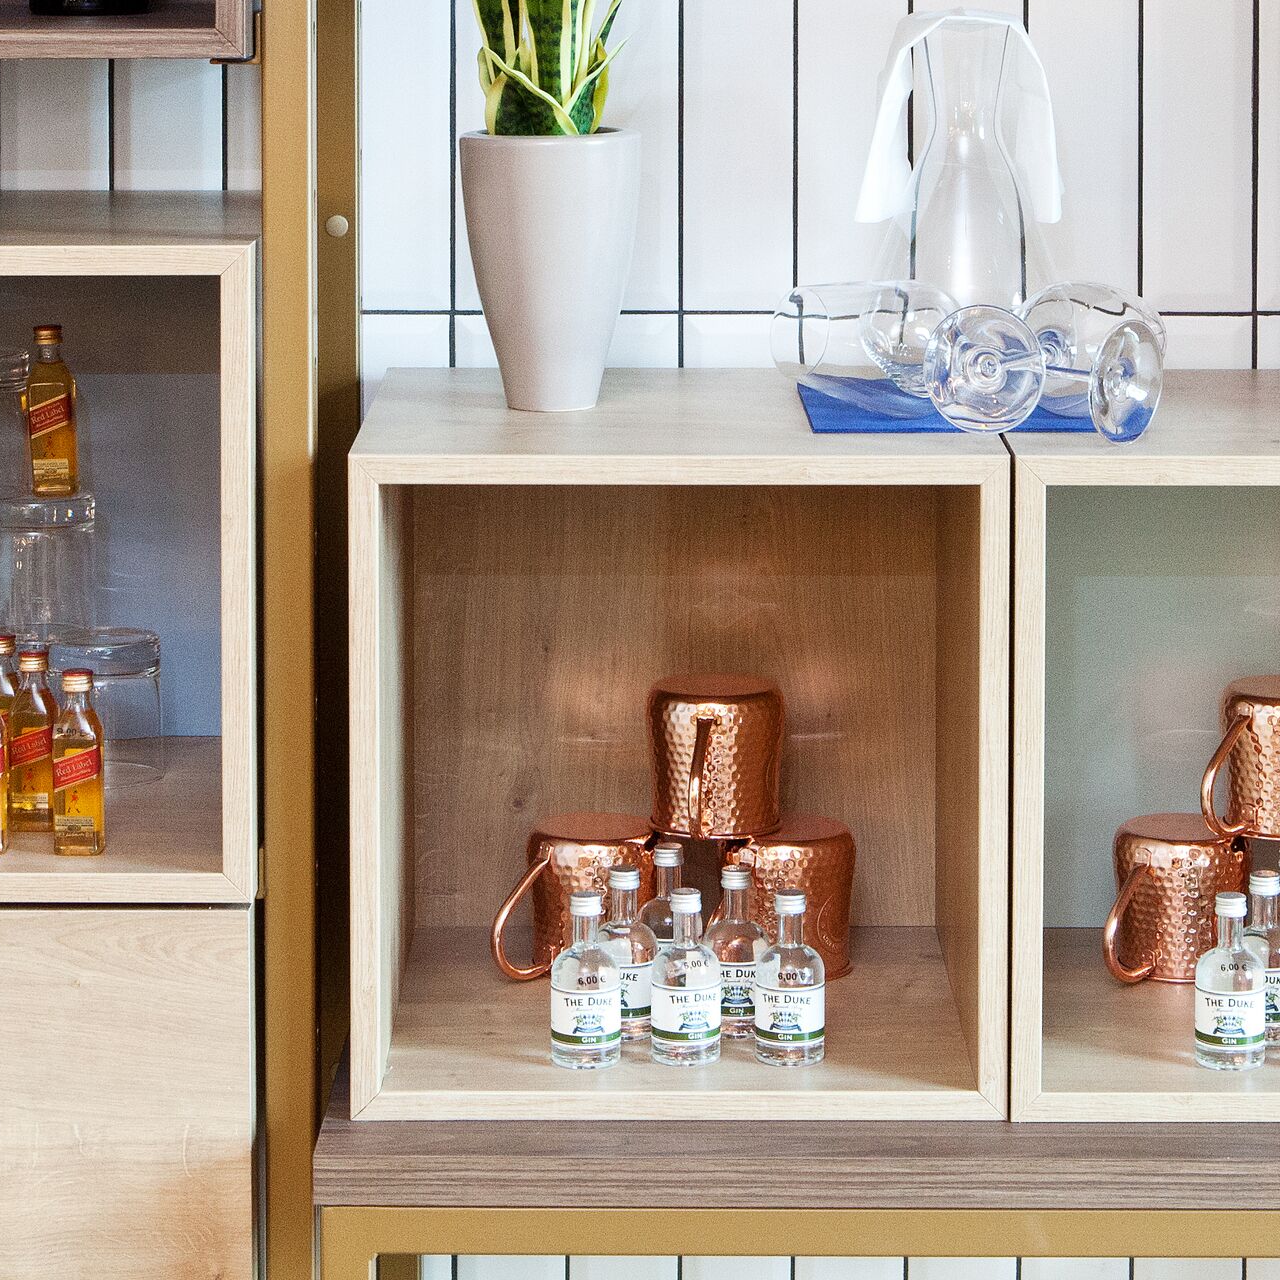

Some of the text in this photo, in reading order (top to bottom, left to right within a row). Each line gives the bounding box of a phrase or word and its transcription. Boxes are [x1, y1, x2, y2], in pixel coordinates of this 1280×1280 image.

[46, 406, 65, 419] Label
[72, 759, 93, 772] Label
[1220, 963, 1240, 972] 6,00
[620, 972, 639, 982] UKE
[720, 969, 756, 978] HE DUK
[777, 972, 798, 981] 6,00
[578, 975, 598, 986] 6,00
[564, 997, 613, 1007] THE DUKE
[669, 993, 717, 1004] THE DUKE
[762, 993, 812, 1005] THE DUKE
[1205, 997, 1256, 1008] THE DUKE
[581, 1036, 597, 1044] GIN
[687, 1032, 703, 1040] GIN
[777, 1033, 793, 1041] GIN
[1221, 1037, 1237, 1045] GIN
